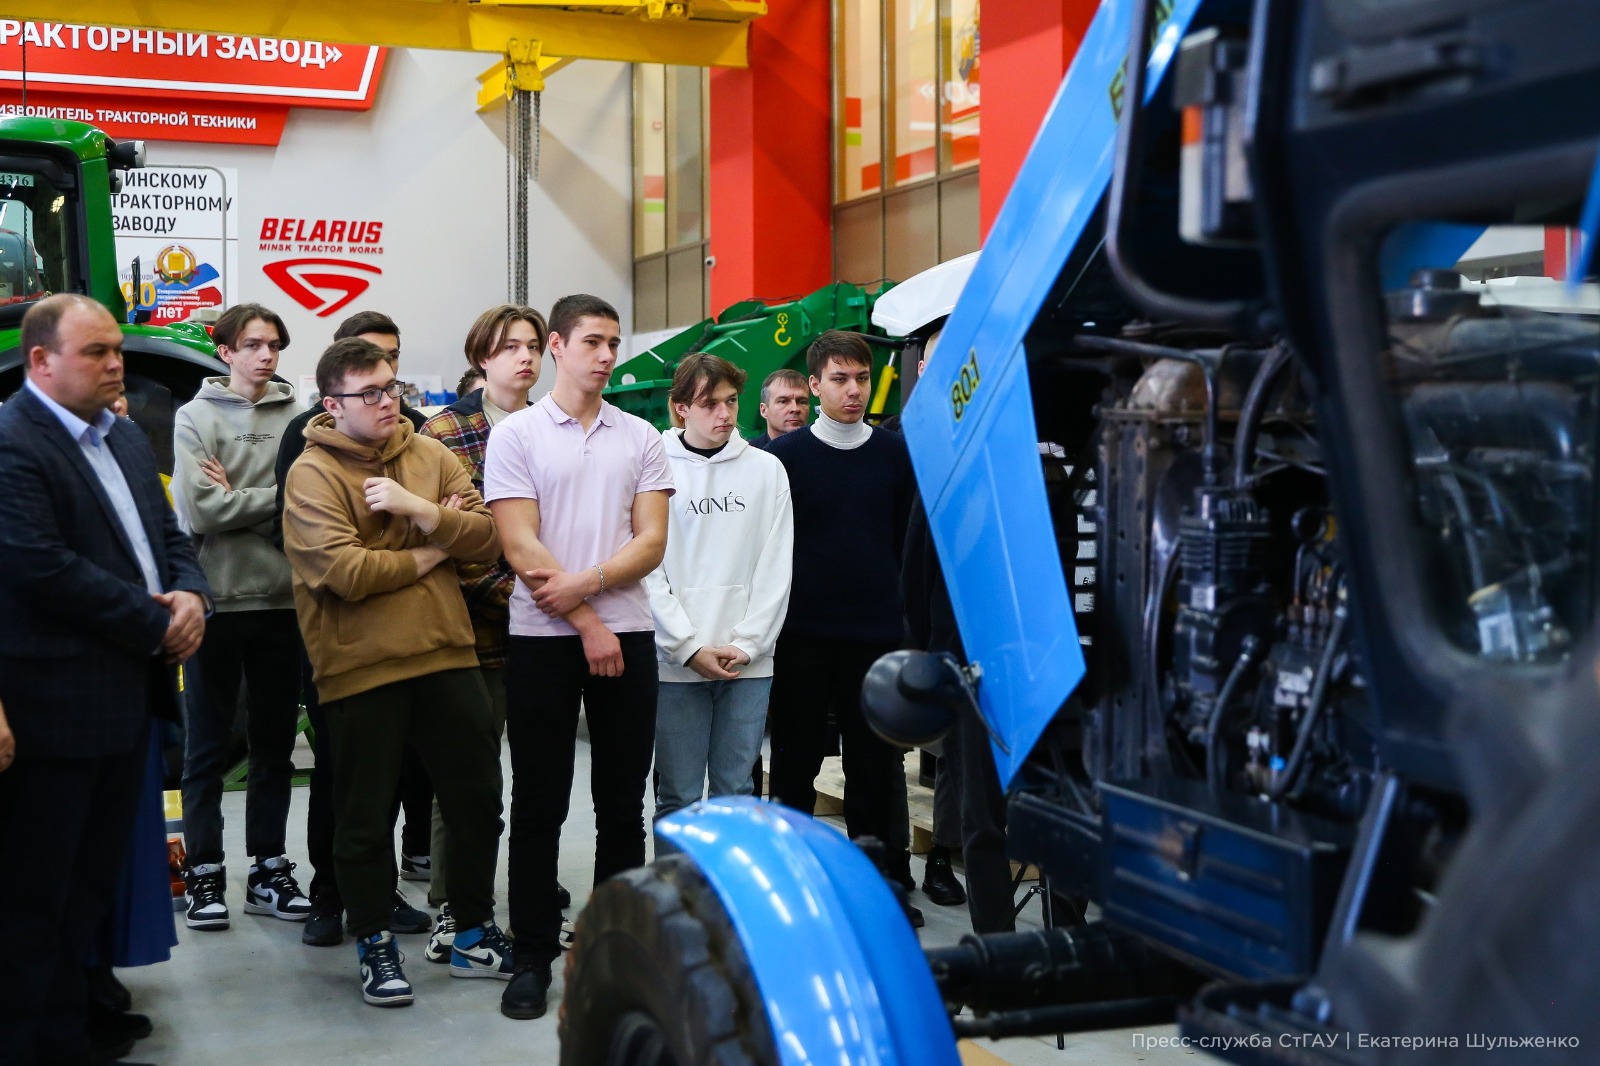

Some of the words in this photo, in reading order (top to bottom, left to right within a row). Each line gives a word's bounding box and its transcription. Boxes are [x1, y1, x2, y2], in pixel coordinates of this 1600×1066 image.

[215, 35, 344, 70] ЗАВОД»
[96, 109, 189, 127] ТРАКТОРНОЙ
[192, 114, 257, 130] ТЕХНИКИ
[125, 172, 207, 189] ИНСКОМУ
[112, 215, 176, 234] ЗАВОДУ
[259, 217, 383, 244] BELARUS
[259, 243, 292, 252] MINSK
[298, 244, 344, 254] TRACTOR
[349, 246, 384, 255] WORKS
[156, 306, 184, 319] лет
[952, 347, 981, 422] 80.1
